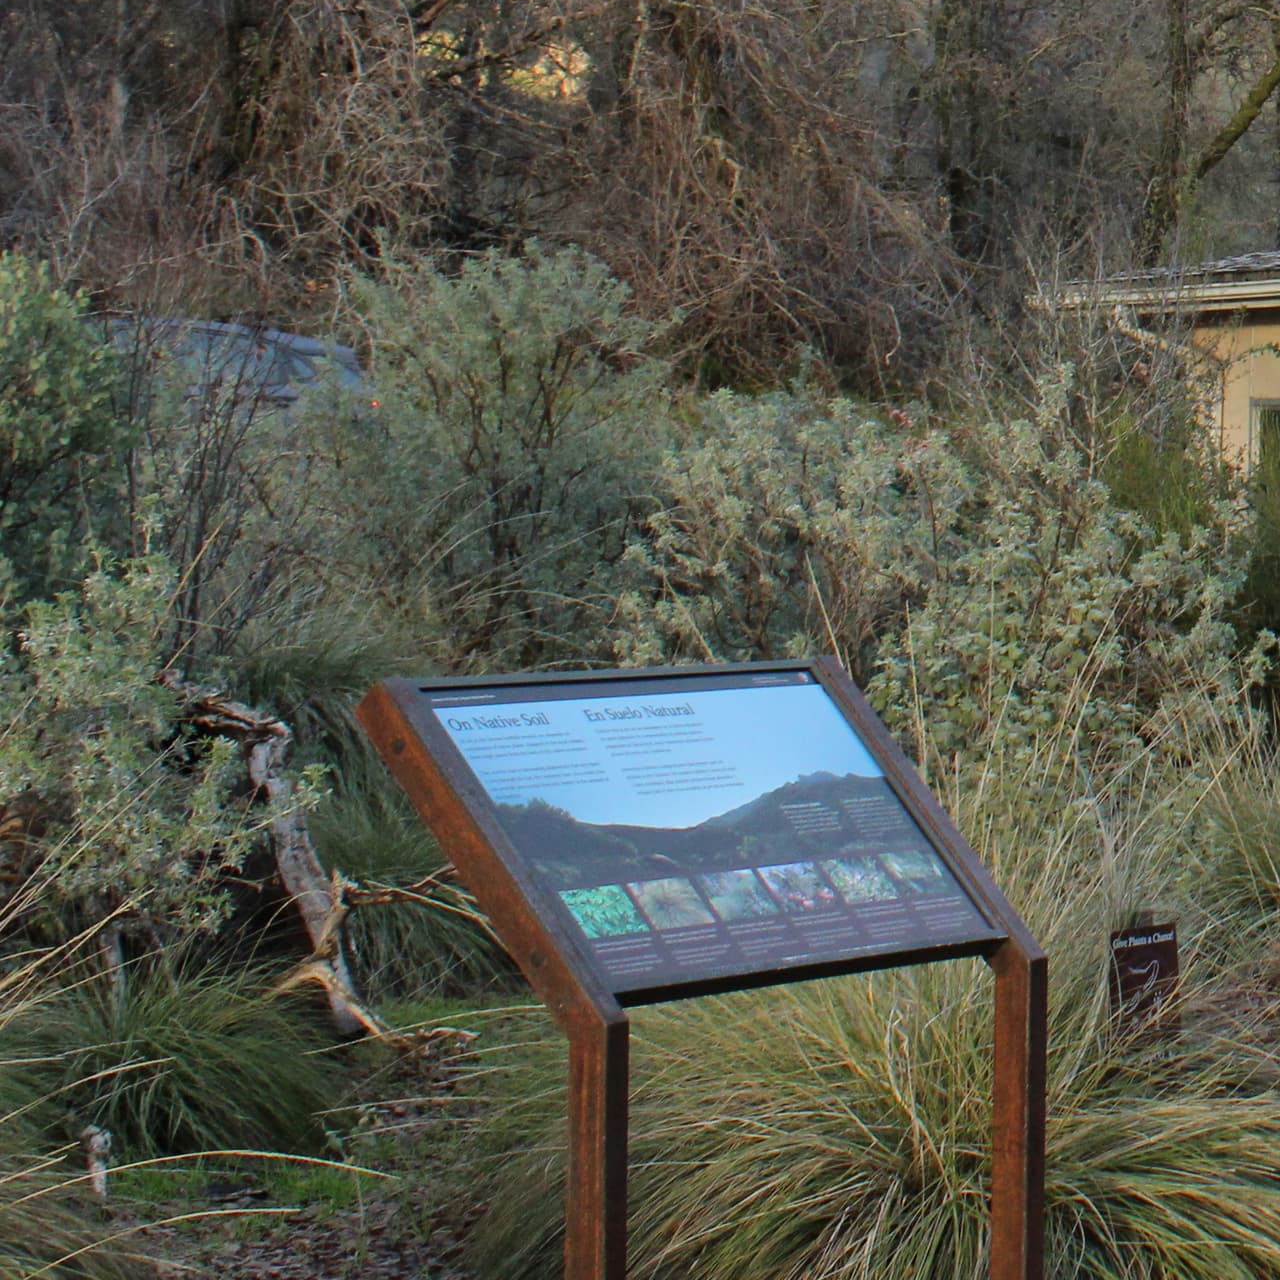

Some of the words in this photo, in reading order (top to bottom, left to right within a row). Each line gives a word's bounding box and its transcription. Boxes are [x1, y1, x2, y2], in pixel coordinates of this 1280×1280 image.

[448, 718, 472, 732] On
[477, 715, 520, 730] Native
[524, 712, 550, 726] Soil
[583, 709, 606, 723] En
[608, 706, 643, 721] Suelo
[645, 703, 695, 719] Natural
